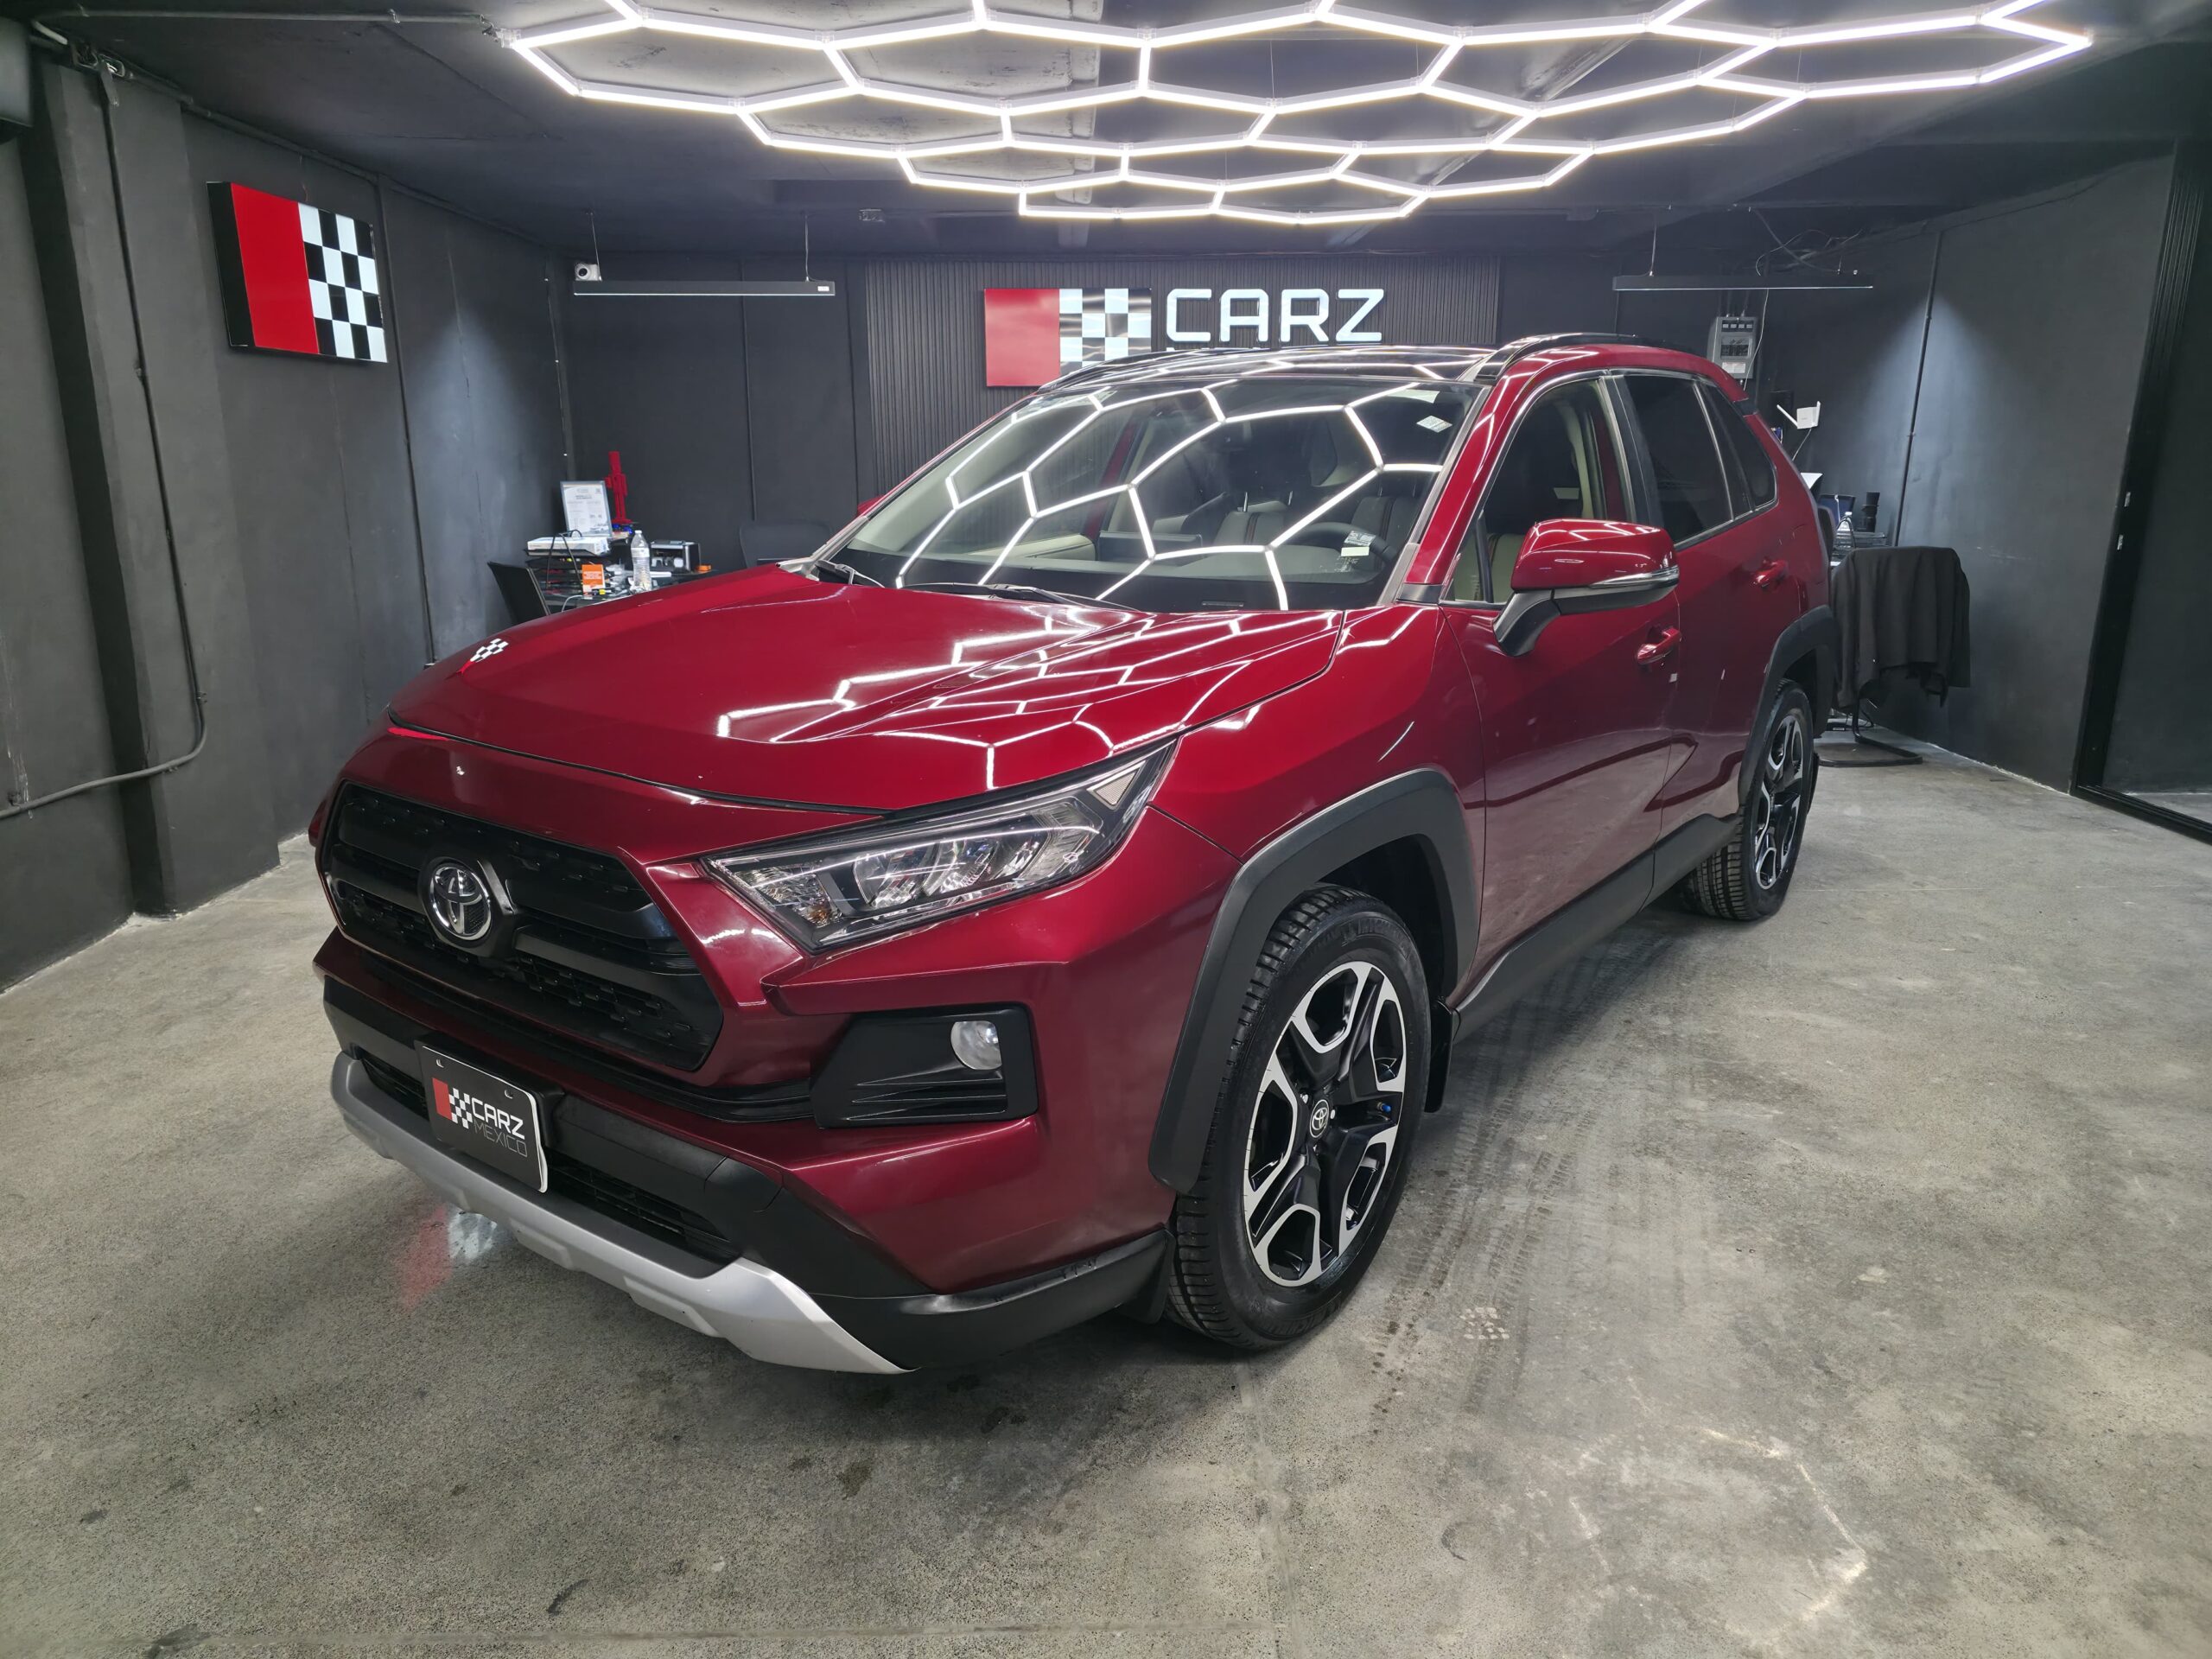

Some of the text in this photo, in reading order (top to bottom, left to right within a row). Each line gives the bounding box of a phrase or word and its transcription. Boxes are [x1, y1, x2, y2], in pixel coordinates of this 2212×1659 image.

[1166, 288, 1384, 342] CARZ
[471, 1096, 525, 1140] CARZ
[474, 1122, 528, 1158] MEXICO
